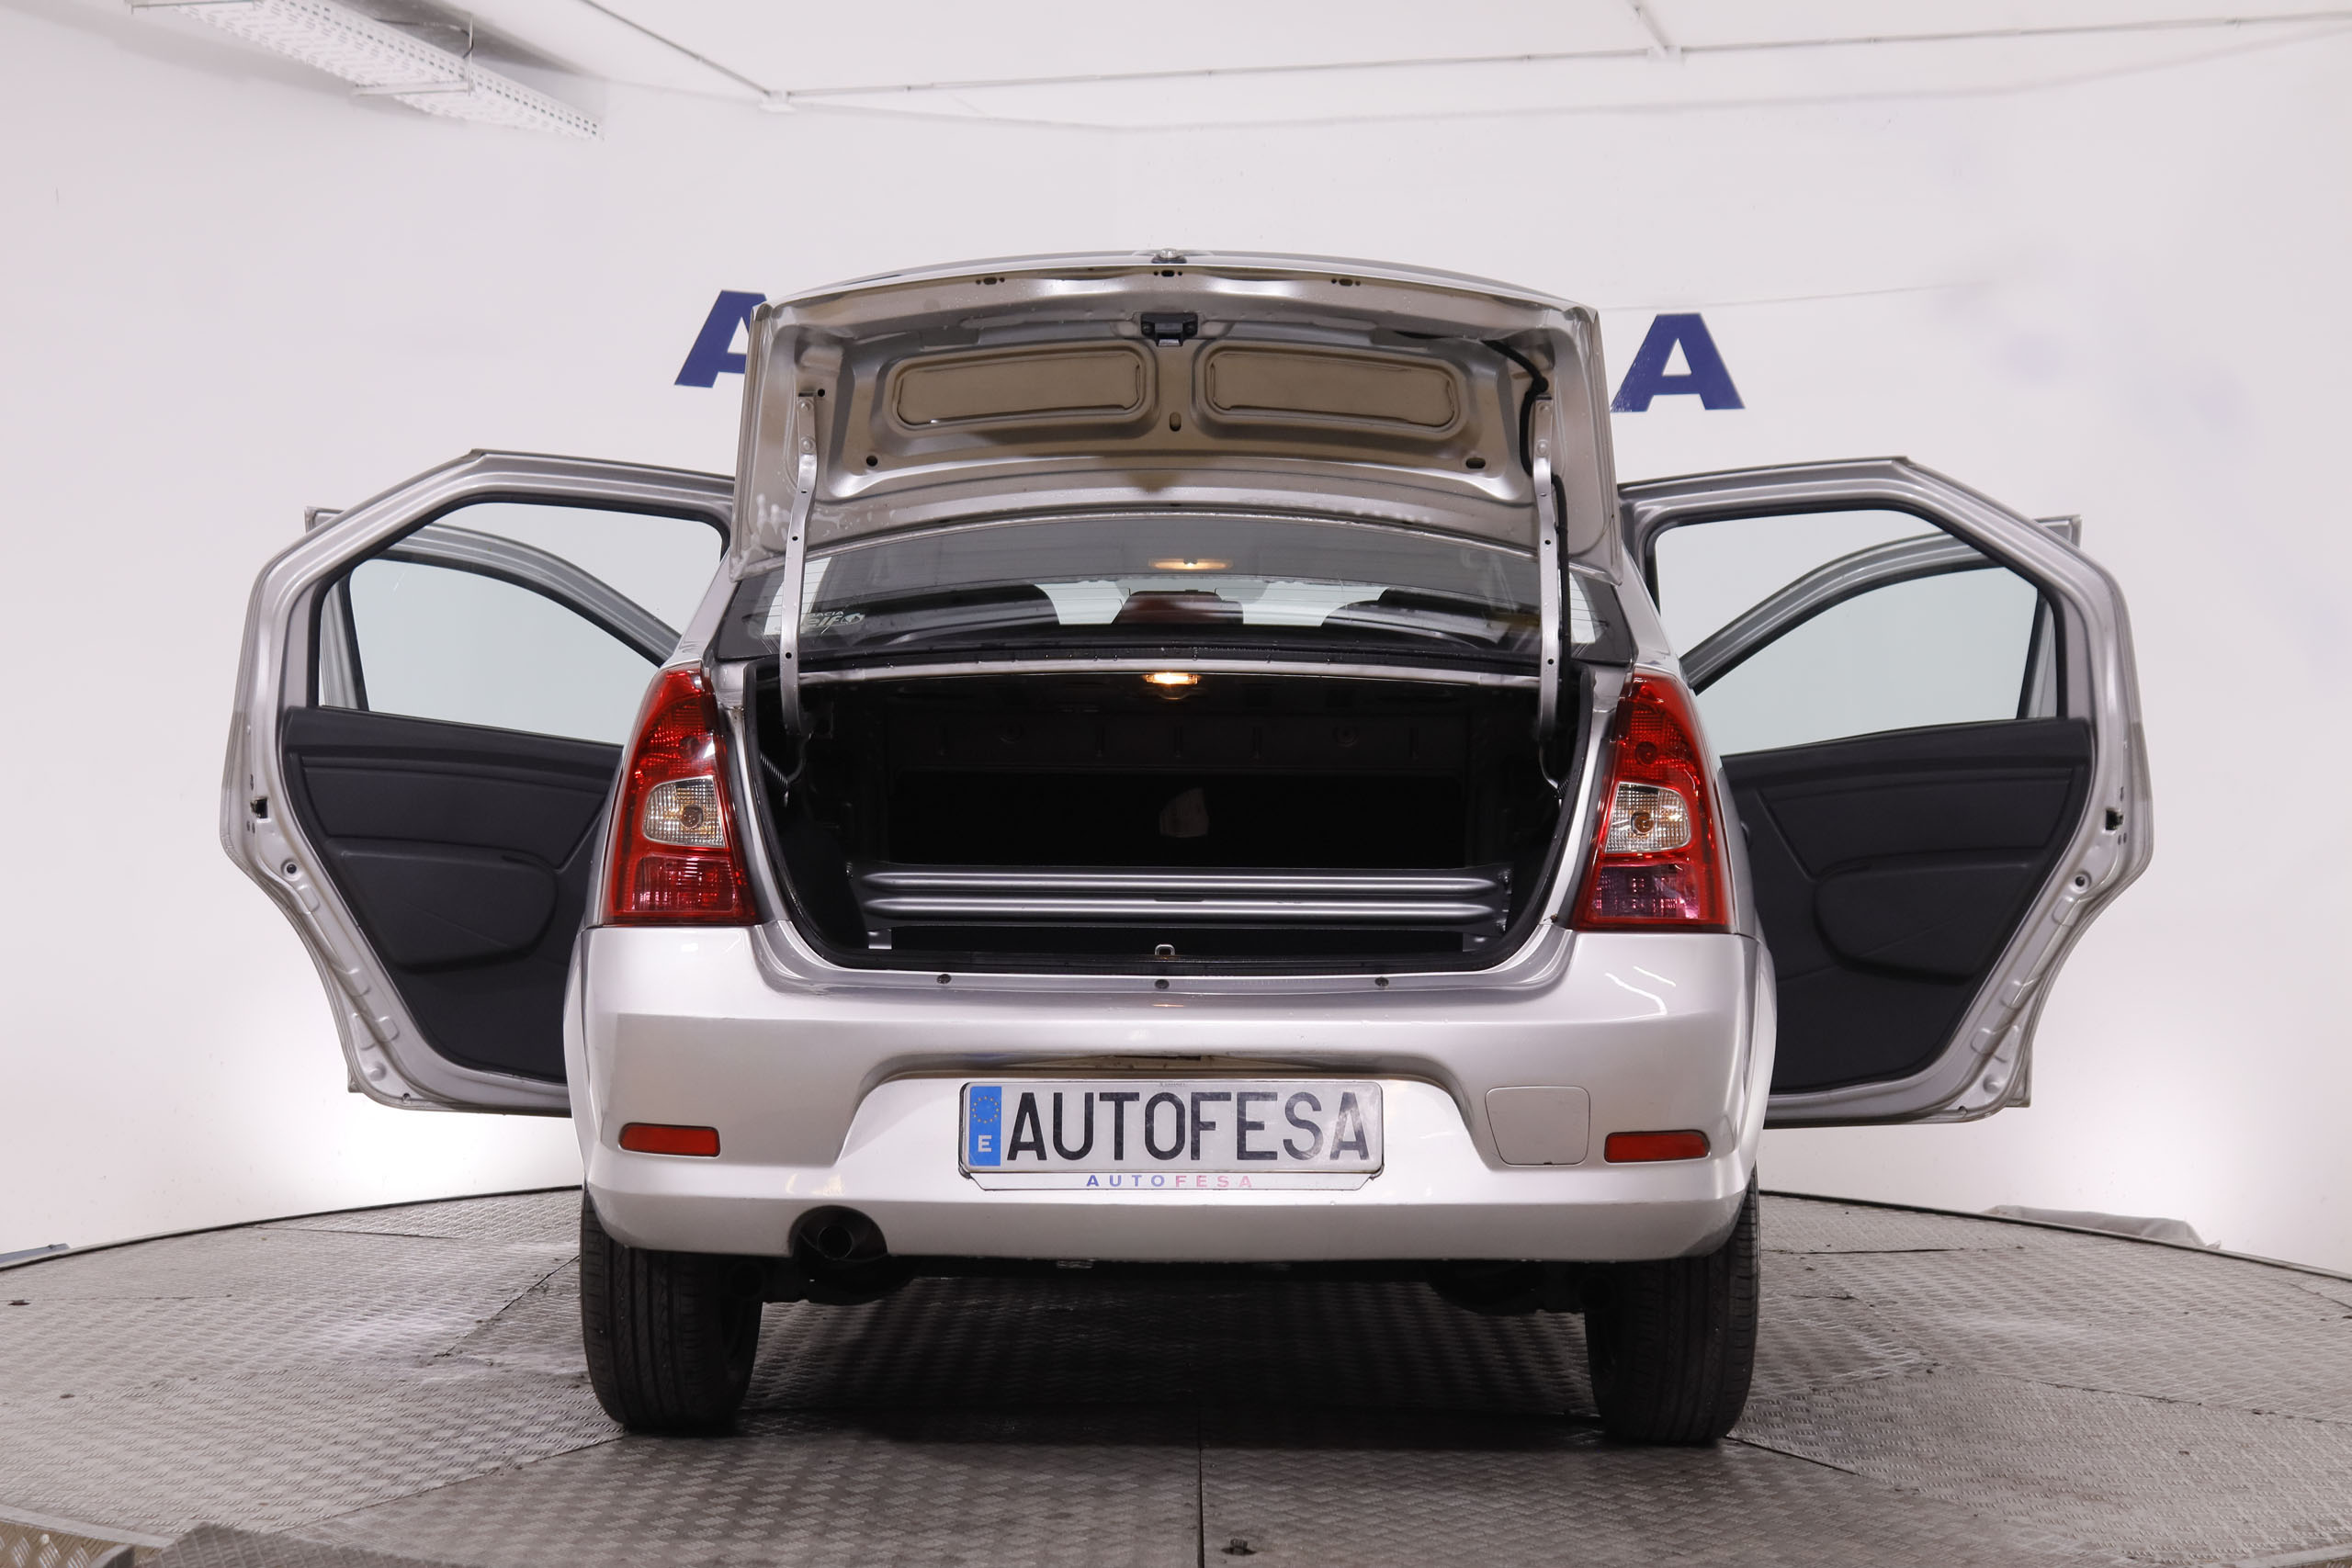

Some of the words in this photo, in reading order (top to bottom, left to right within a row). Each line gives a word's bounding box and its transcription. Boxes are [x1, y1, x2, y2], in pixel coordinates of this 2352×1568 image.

[1610, 312, 1746, 413] A
[978, 1134, 992, 1153] E
[1007, 1091, 1370, 1161] AUTOFESA
[1086, 1174, 1251, 1188] AUTOFESA
